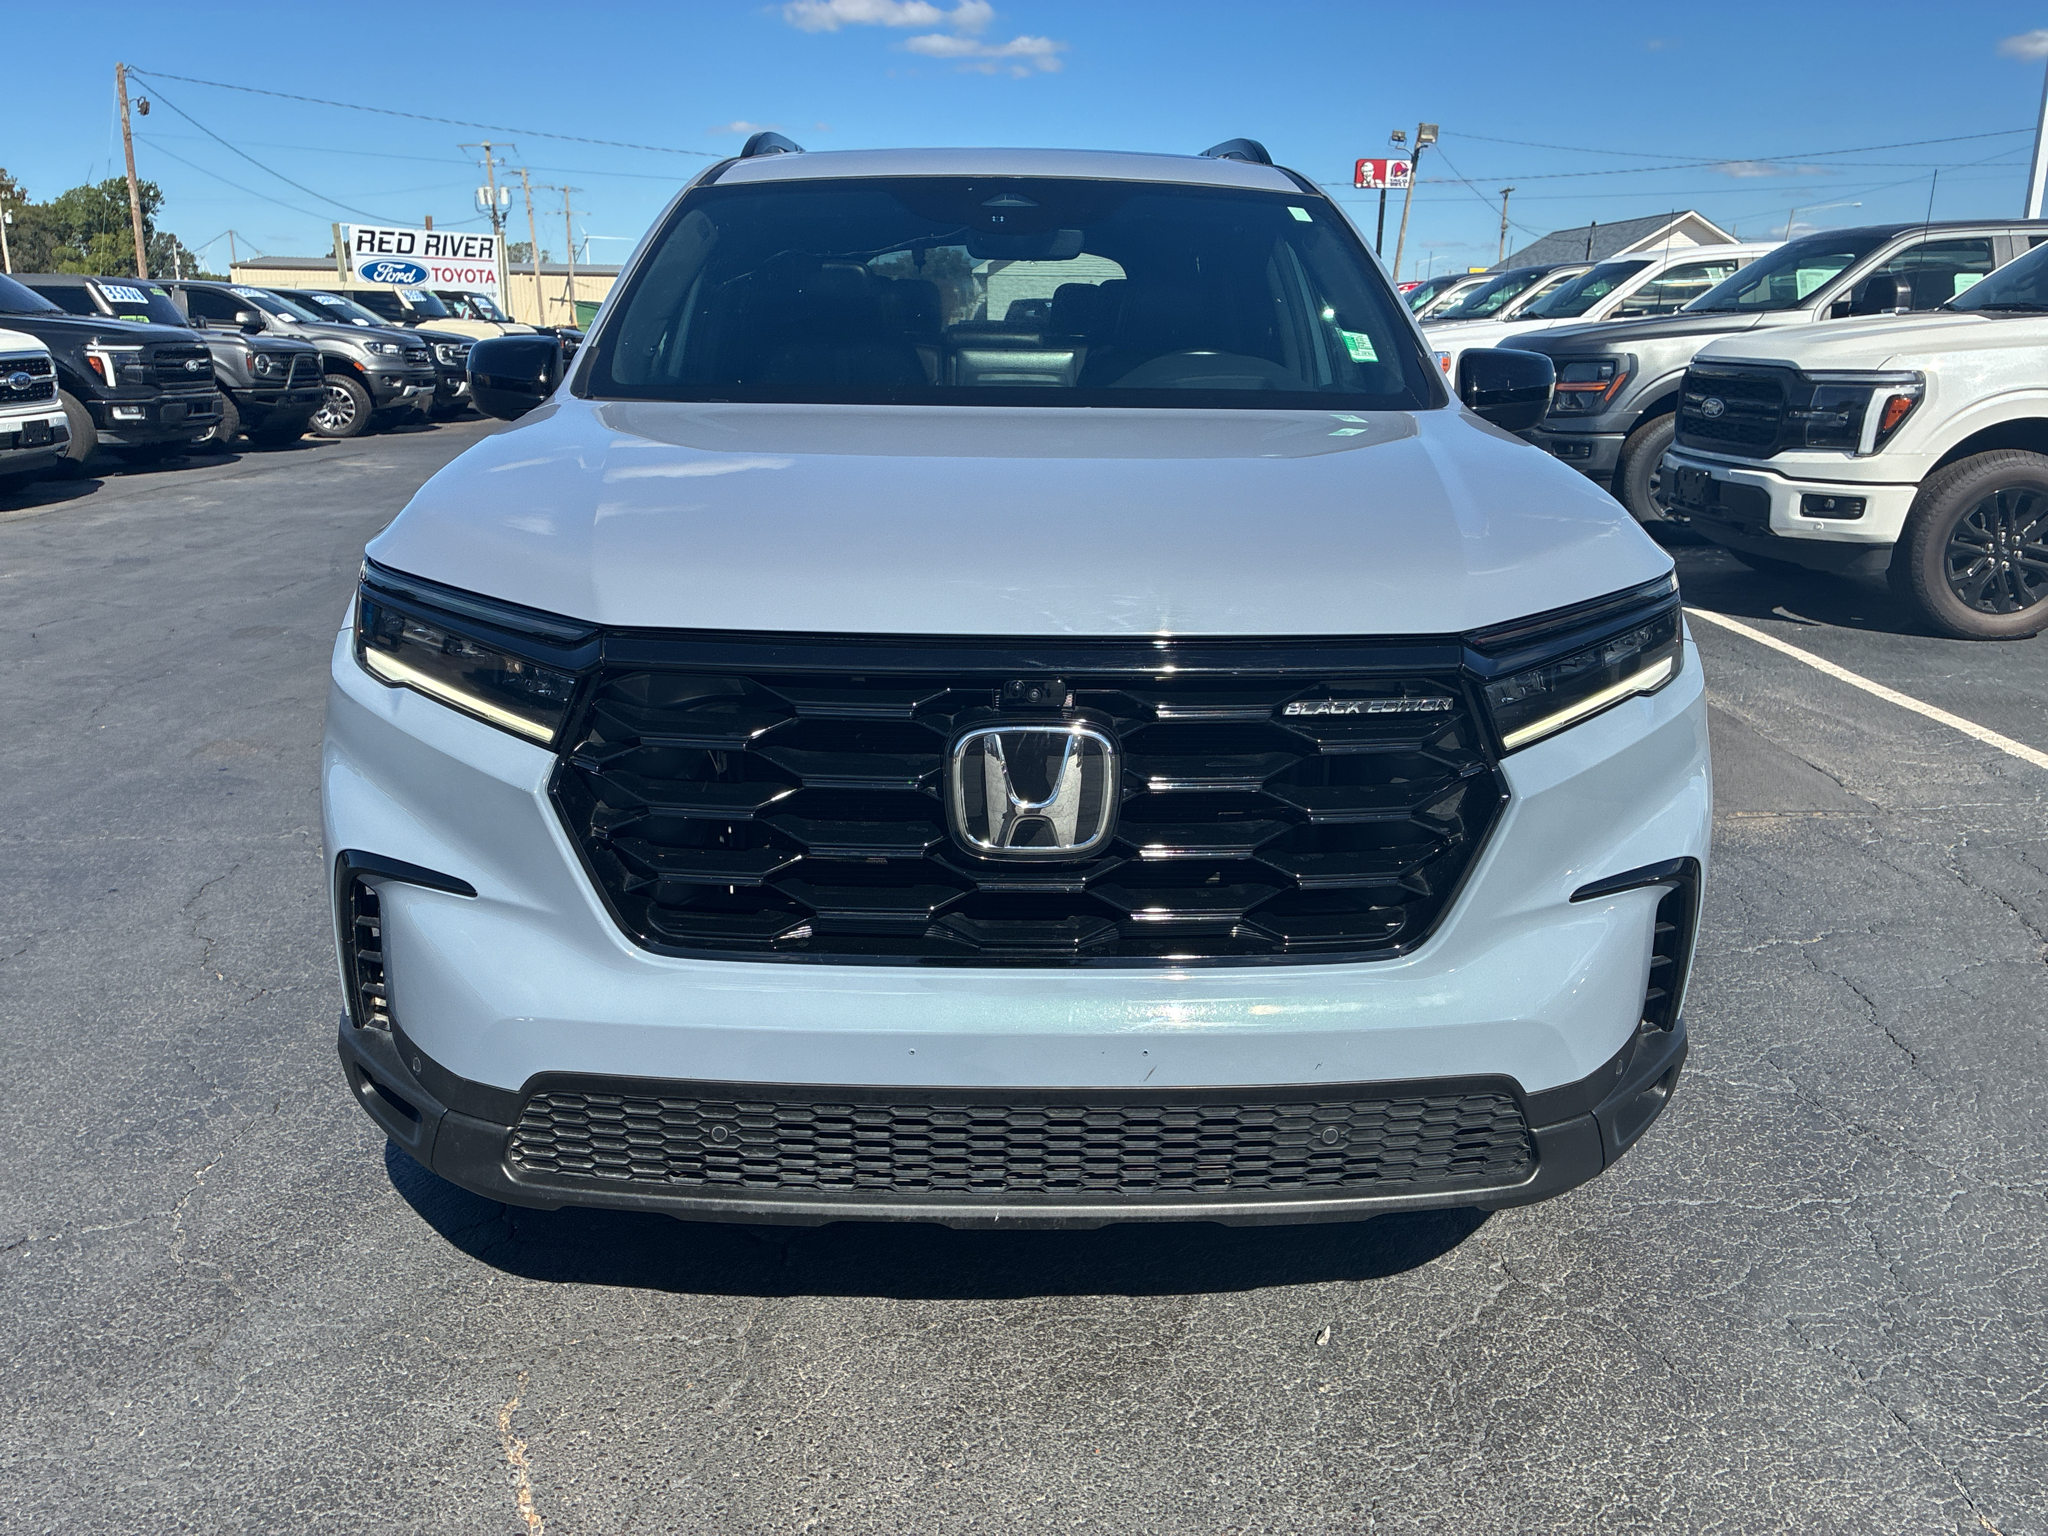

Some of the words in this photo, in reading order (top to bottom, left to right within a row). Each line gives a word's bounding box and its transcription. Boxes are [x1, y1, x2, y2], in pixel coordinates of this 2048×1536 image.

[356, 229, 416, 254] RED
[424, 234, 494, 259] RIVER
[373, 262, 417, 284] Ford
[431, 267, 496, 284] TOYOTA
[1284, 701, 1360, 716] BLACK
[1367, 699, 1452, 714] EDITION
